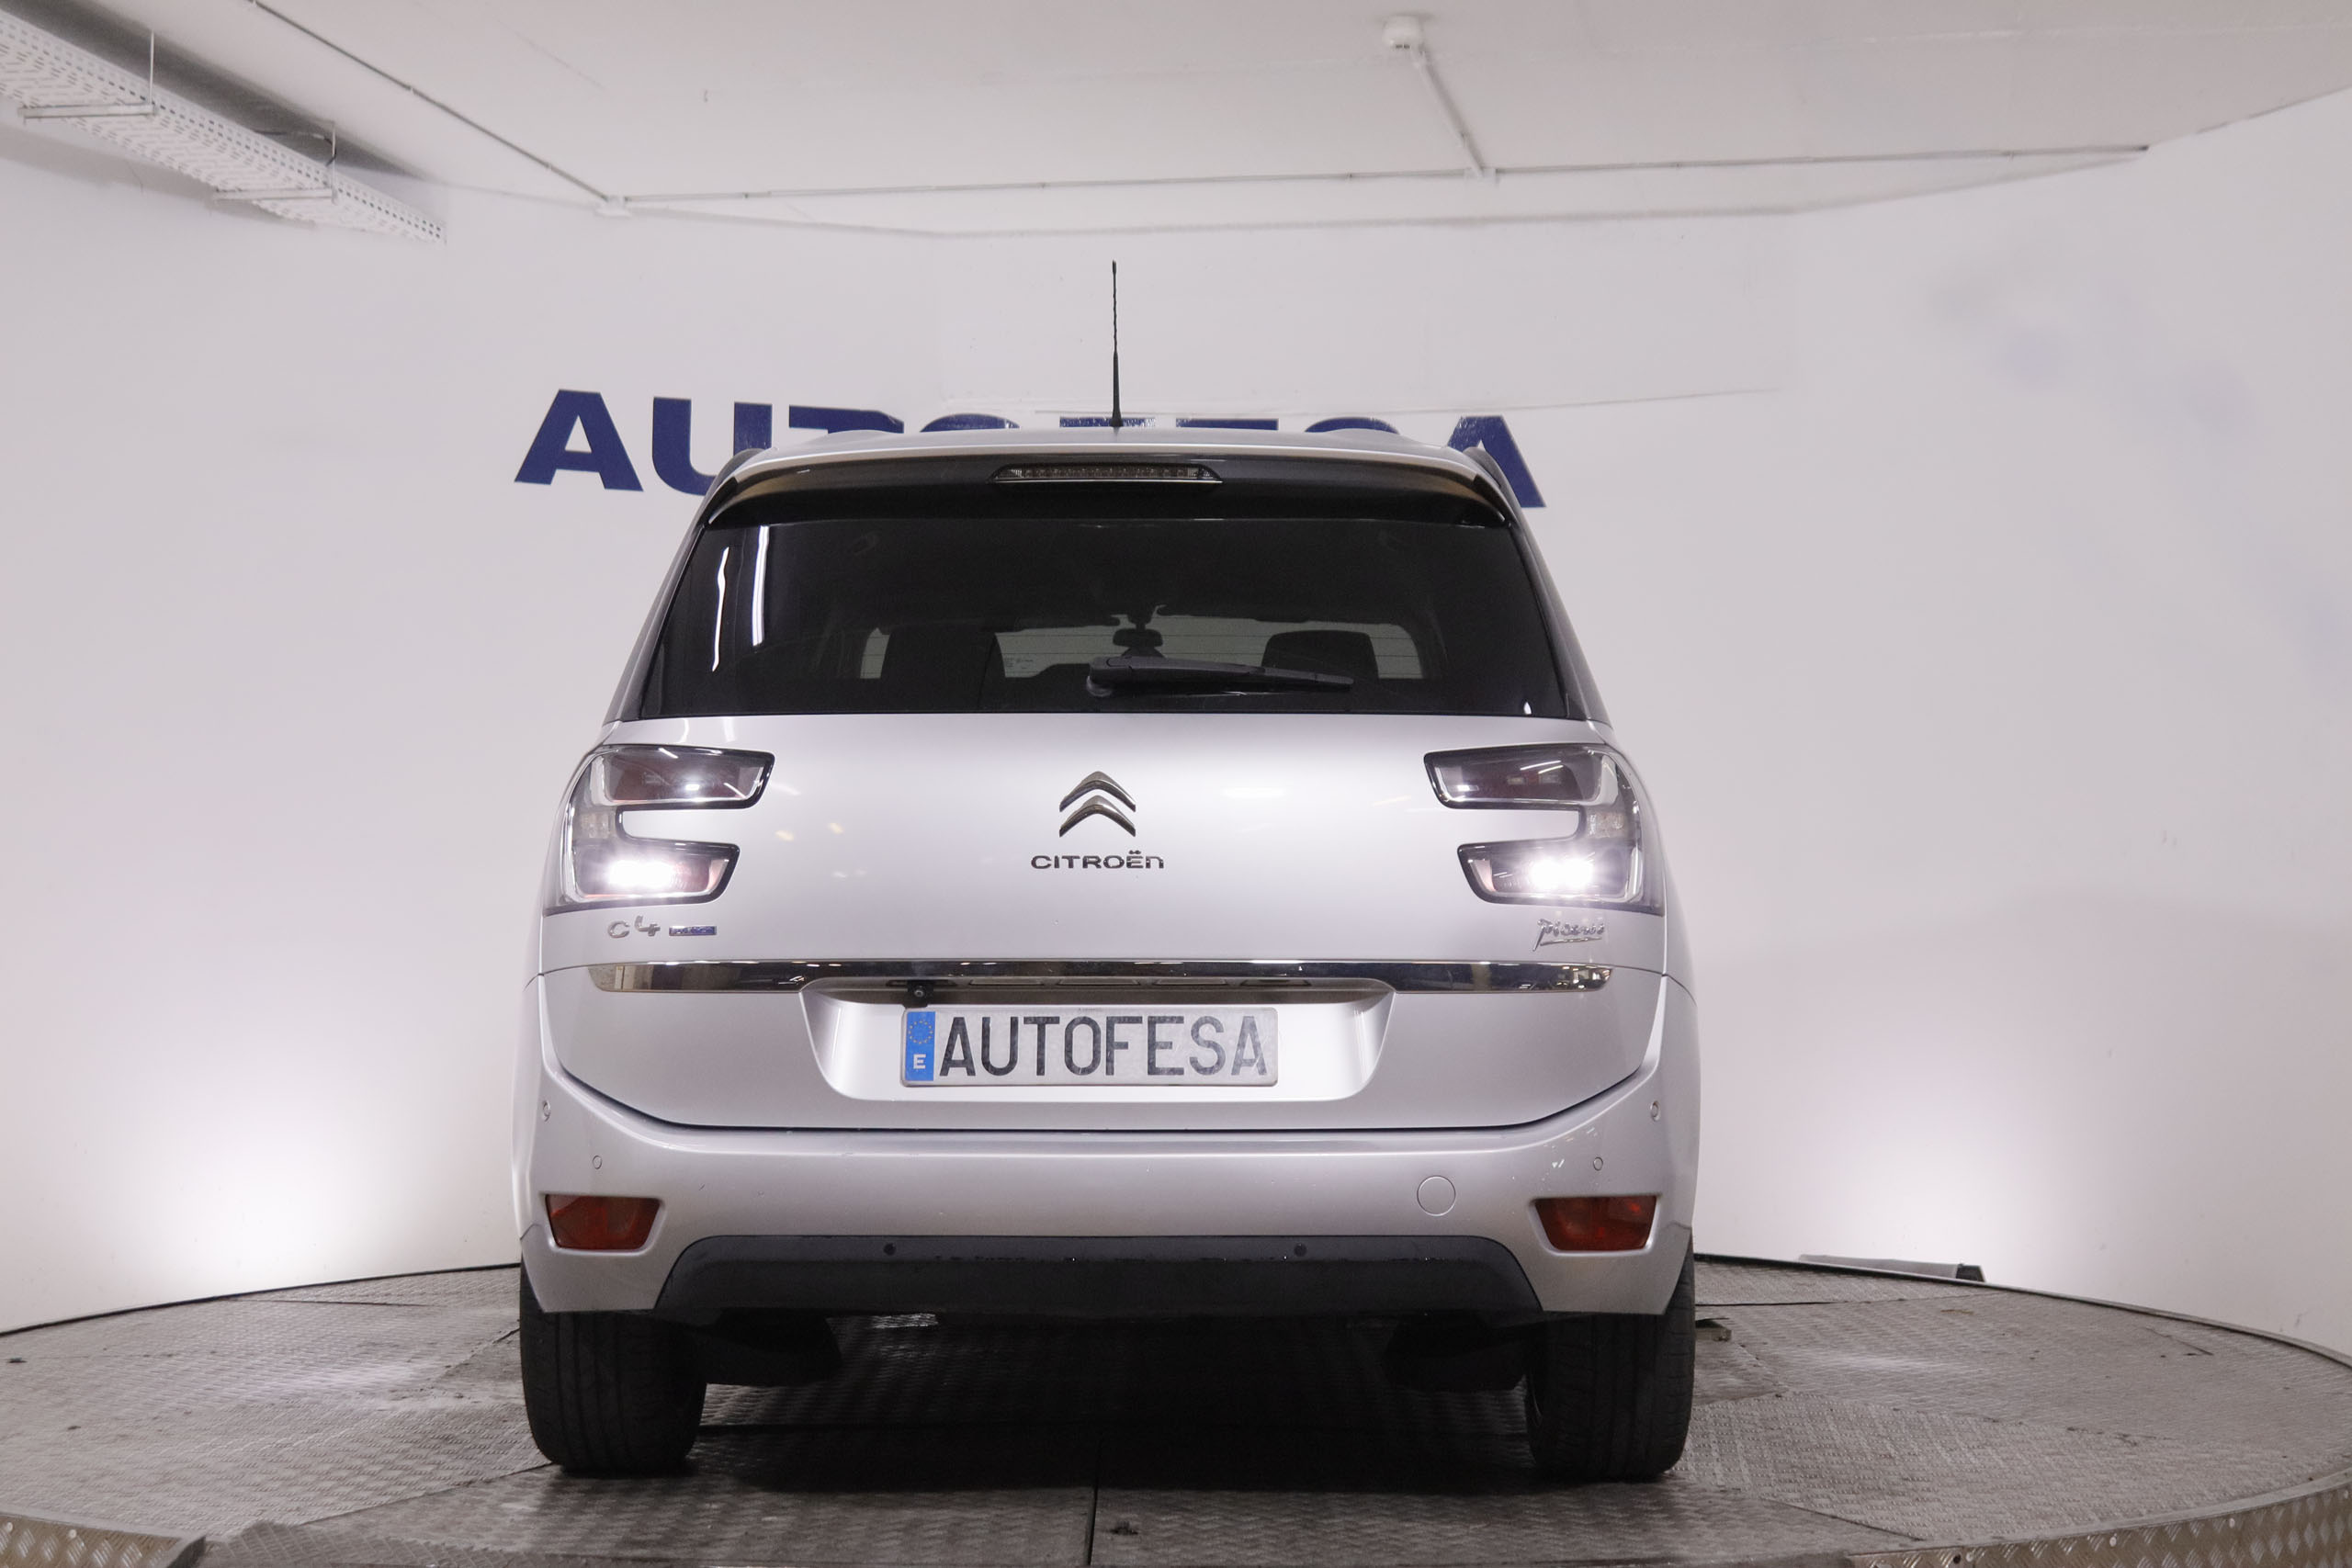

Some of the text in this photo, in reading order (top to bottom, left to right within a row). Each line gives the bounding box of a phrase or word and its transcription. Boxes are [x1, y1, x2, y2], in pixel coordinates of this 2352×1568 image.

[607, 915, 661, 939] C4
[912, 1016, 1268, 1077] E AUTOFESA
